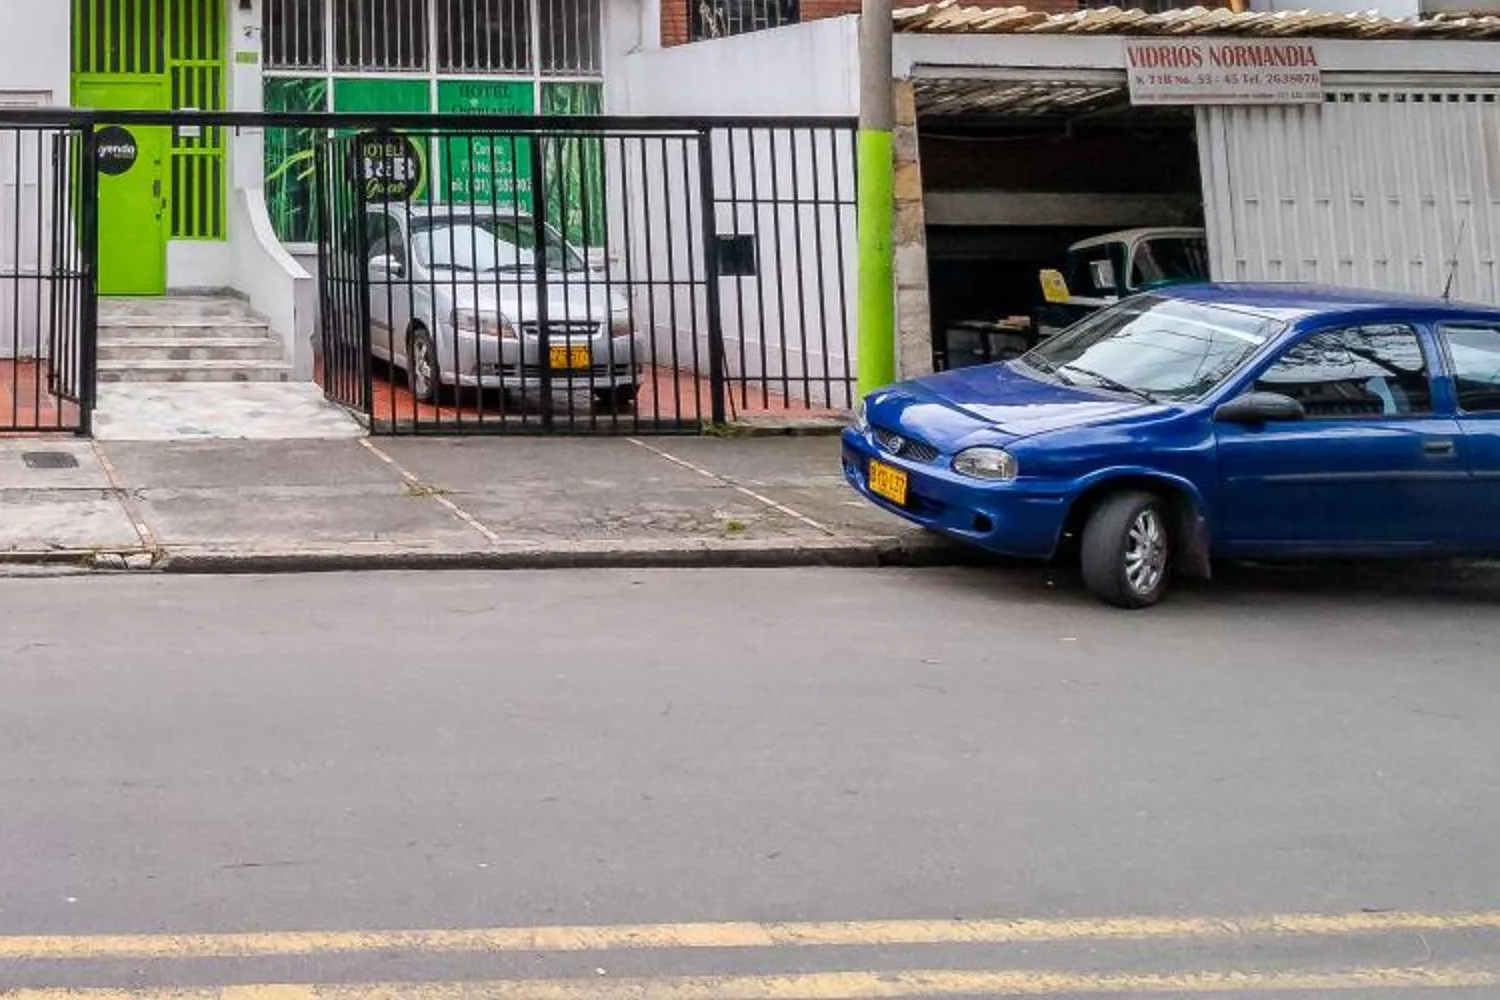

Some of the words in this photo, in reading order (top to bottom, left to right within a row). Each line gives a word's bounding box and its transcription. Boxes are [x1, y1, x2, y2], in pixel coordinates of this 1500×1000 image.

[1127, 45, 1203, 69] VIDRIOS
[1209, 45, 1318, 68] NORMANDIA
[97, 143, 135, 157] yenda
